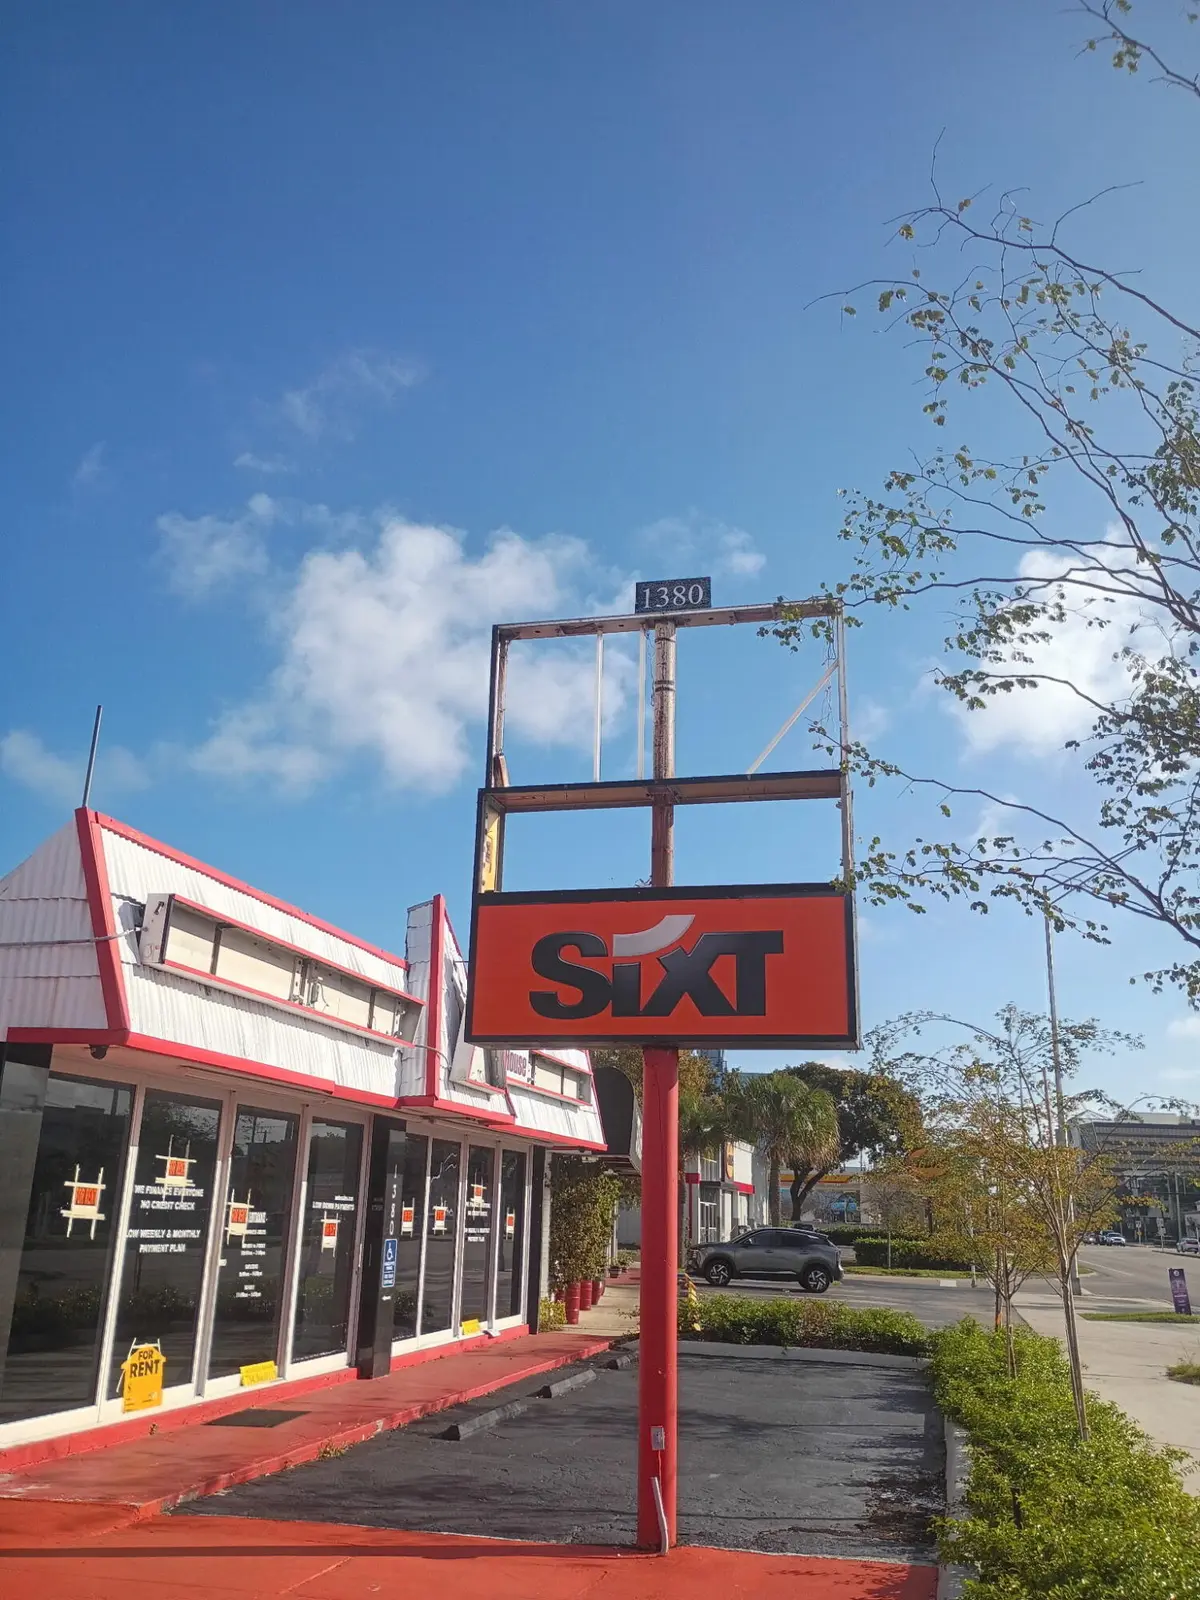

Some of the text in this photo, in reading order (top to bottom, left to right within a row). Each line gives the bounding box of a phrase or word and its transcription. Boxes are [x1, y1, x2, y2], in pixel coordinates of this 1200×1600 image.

[643, 584, 703, 609] 1380
[134, 1184, 145, 1194] WE
[145, 1185, 173, 1196] FINANCE
[140, 1199, 196, 1211] NO CREDIT CHECK
[140, 1229, 166, 1239] WEEKLY
[172, 1229, 201, 1239] MONTHLY
[139, 1243, 187, 1254] PAYMENT PLAN
[137, 1349, 153, 1361] FOR
[129, 1359, 161, 1378] RENT
